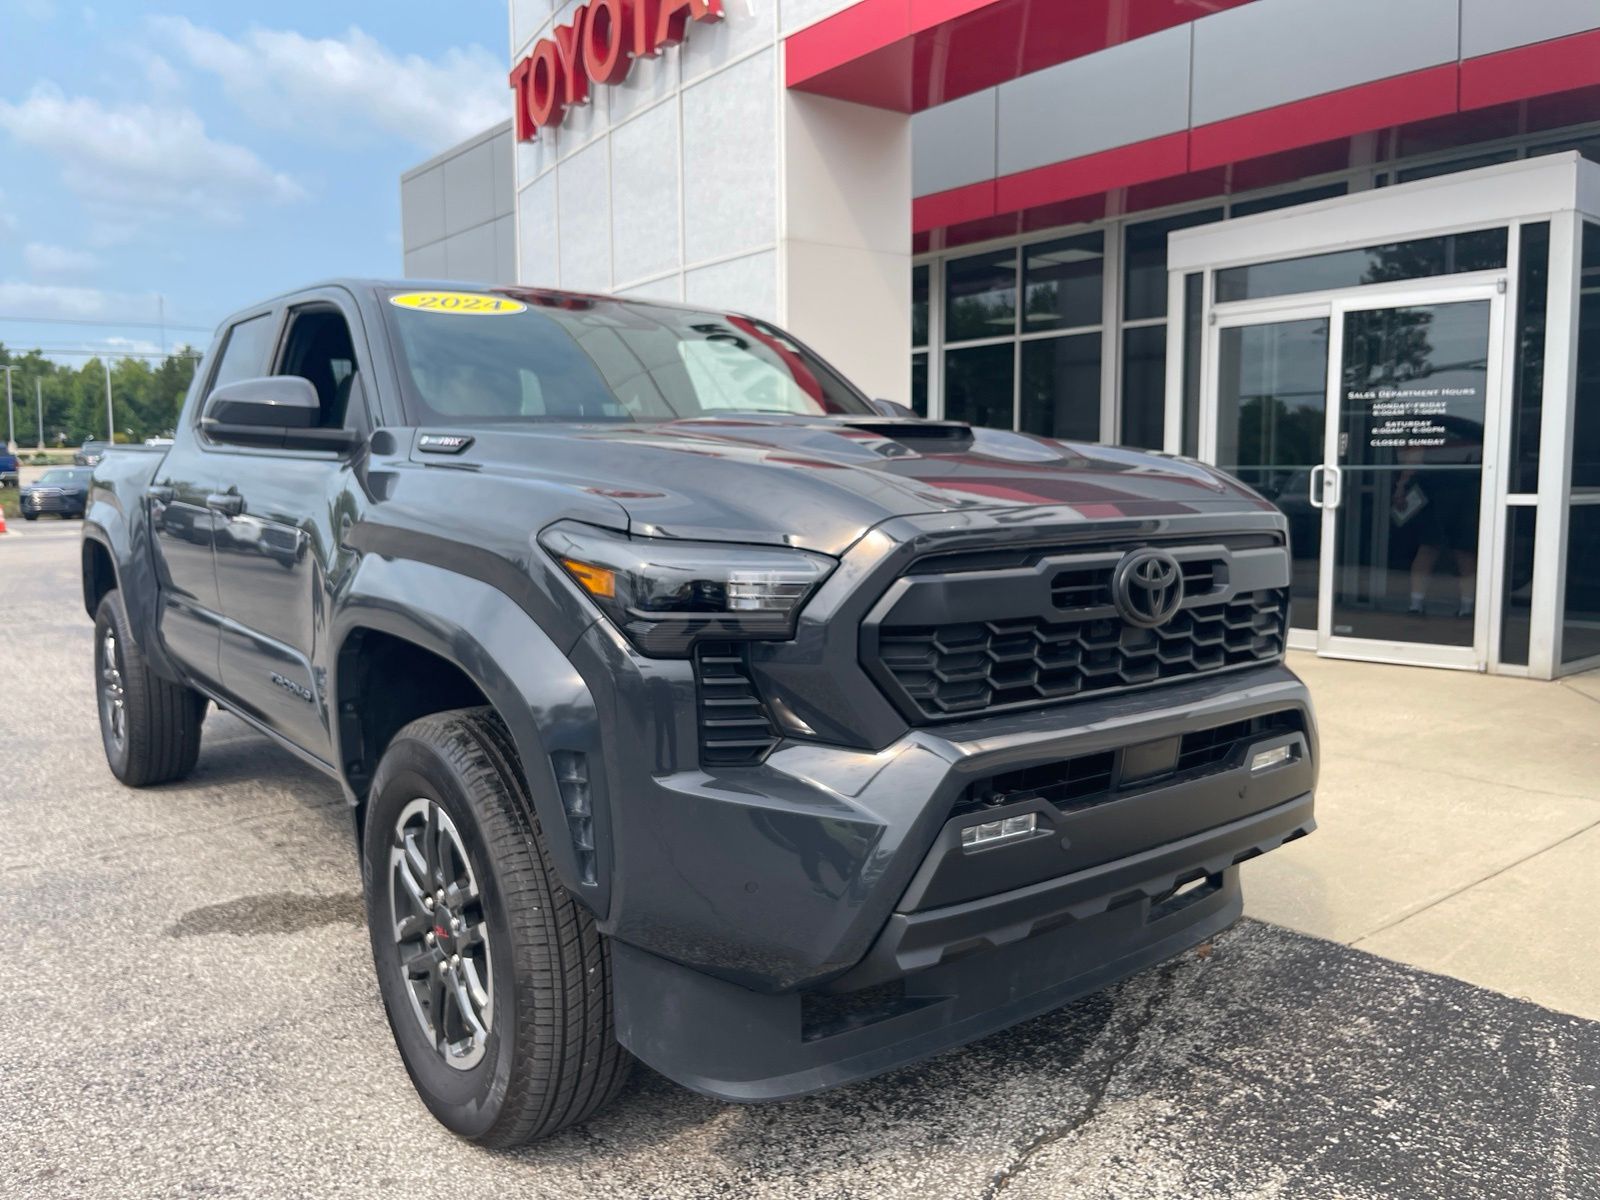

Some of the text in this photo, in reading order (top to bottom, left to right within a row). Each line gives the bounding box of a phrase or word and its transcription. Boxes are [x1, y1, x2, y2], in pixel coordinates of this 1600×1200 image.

[418, 297, 504, 311] 2024
[1384, 420, 1432, 429] SATURDAY
[1370, 438, 1446, 447] CLOSED SUNDAY
